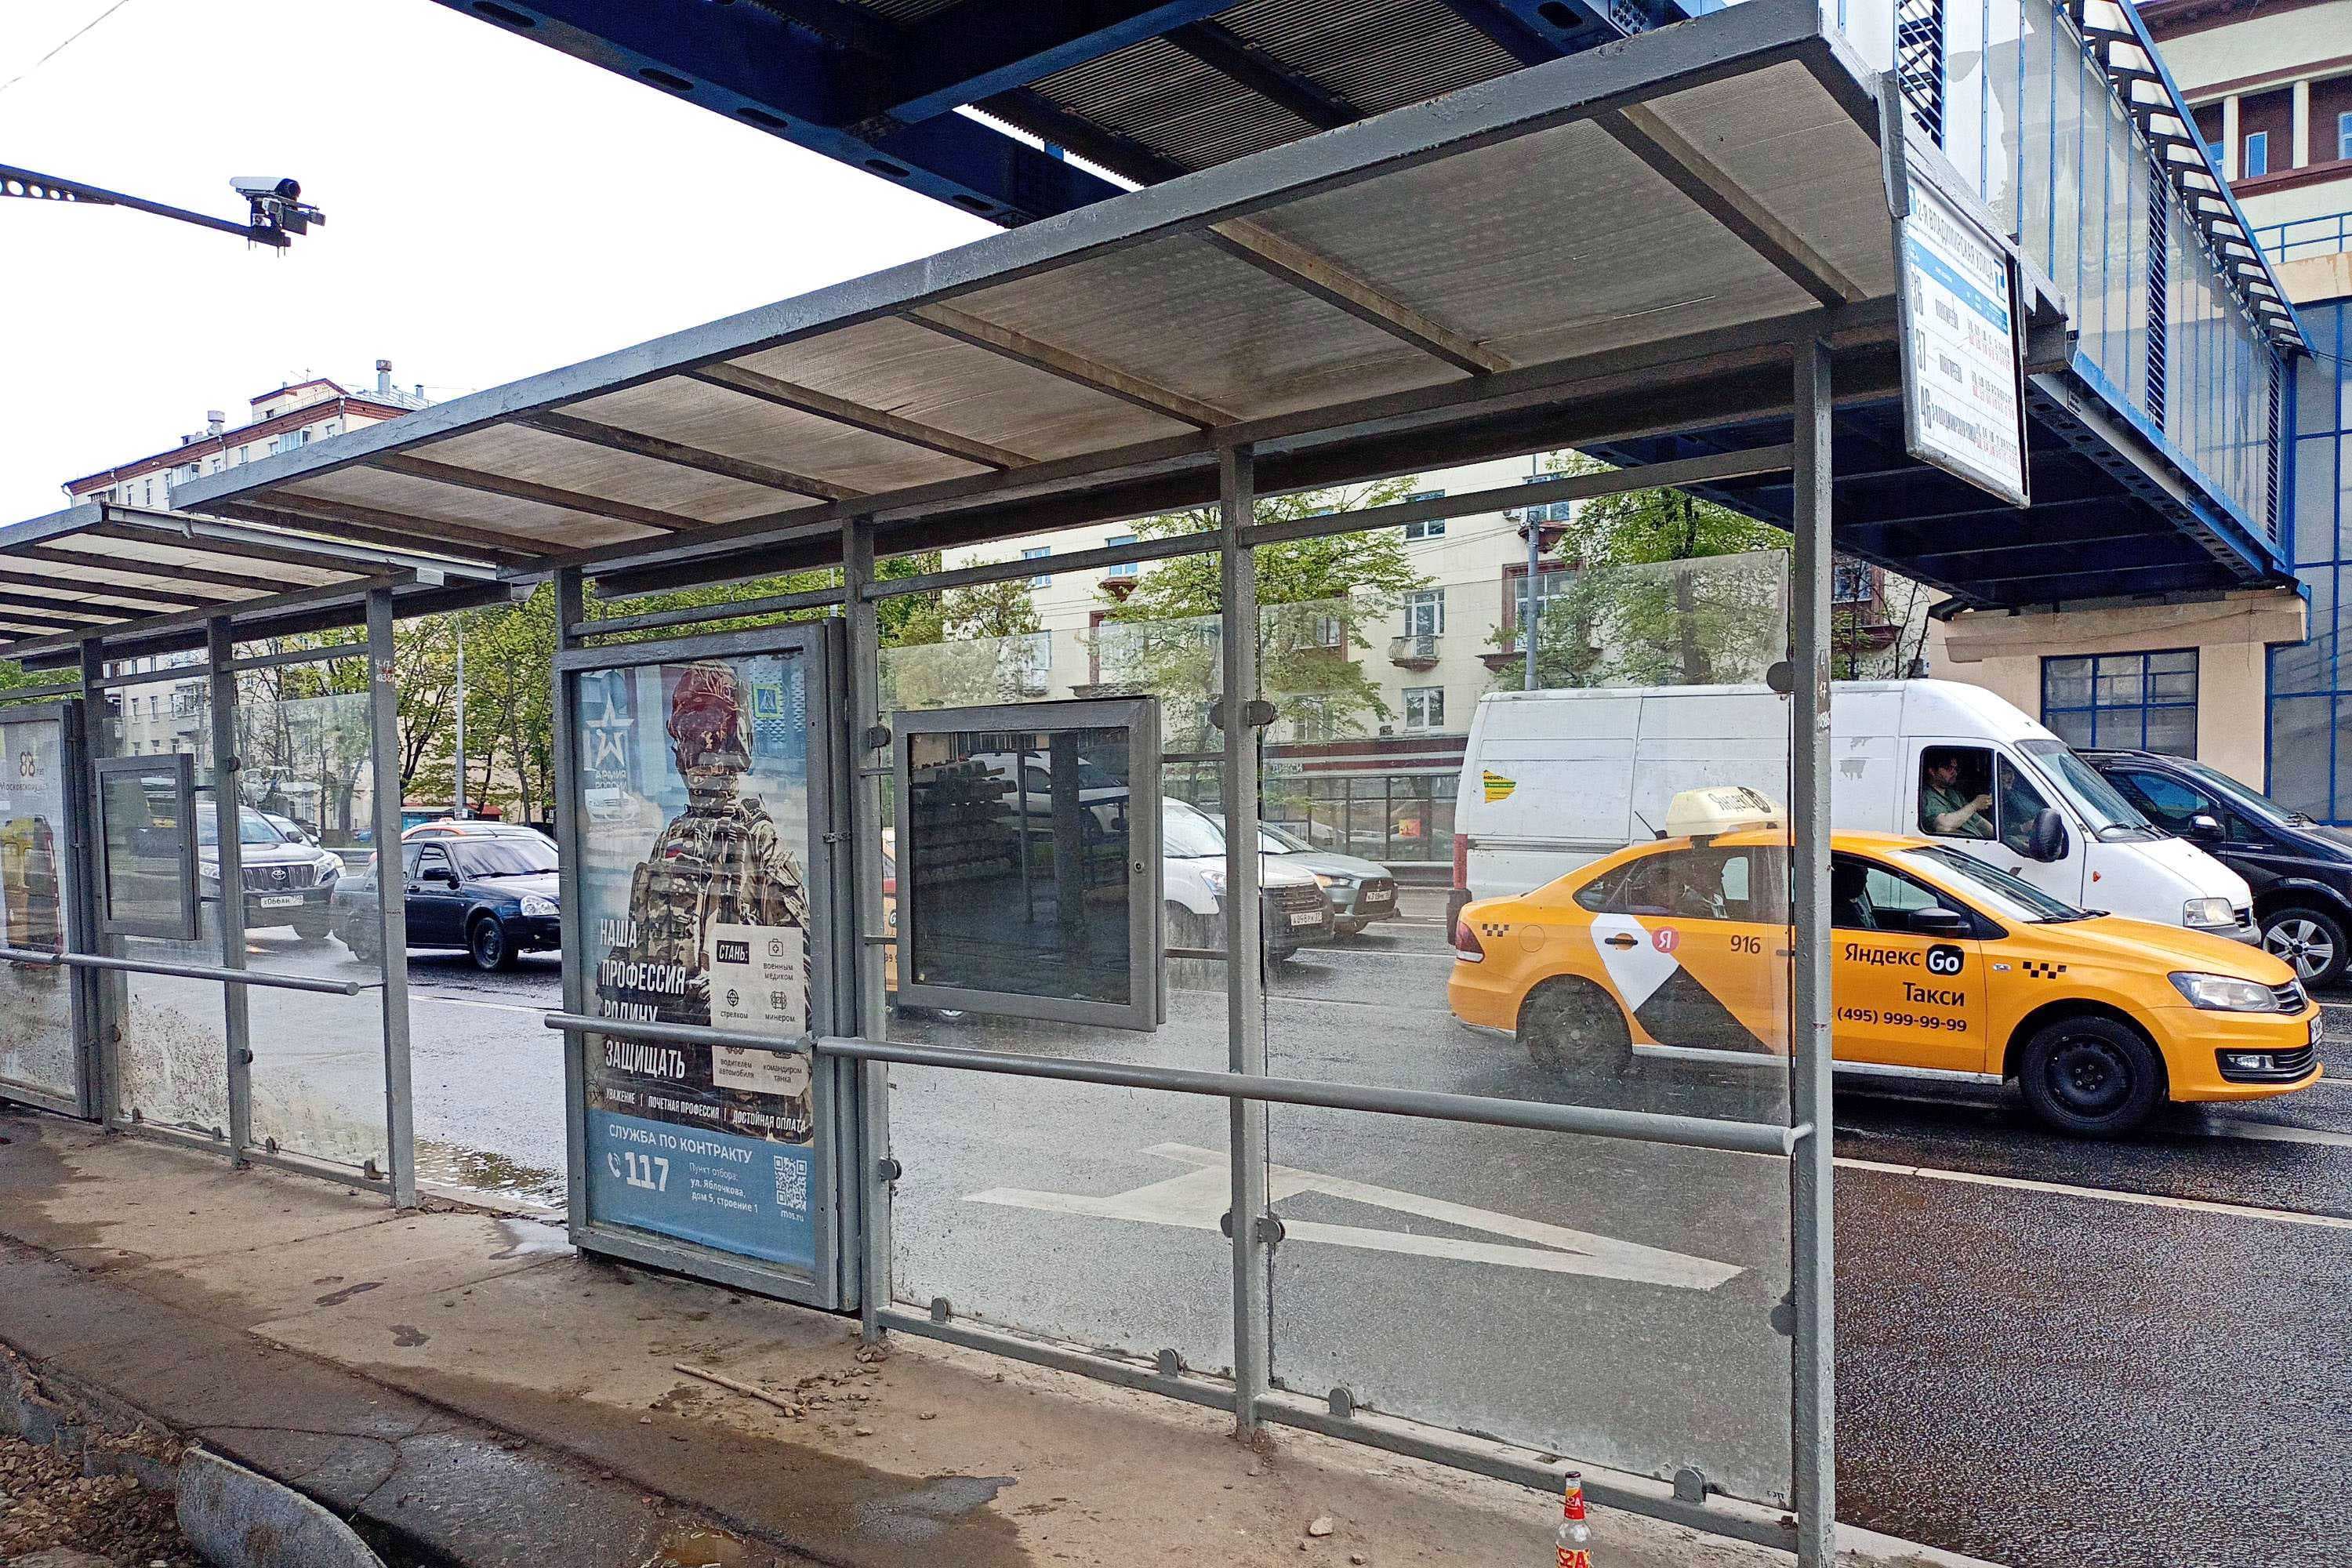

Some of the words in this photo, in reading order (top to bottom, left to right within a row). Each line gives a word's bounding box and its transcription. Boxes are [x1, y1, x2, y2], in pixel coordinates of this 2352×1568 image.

[1915, 328, 1926, 372] 37
[1920, 385, 1932, 430] 46
[20, 751, 35, 777] 88
[595, 770, 626, 779] АРМИЯ
[600, 918, 637, 949] НАША
[1657, 930, 1672, 949] Я
[719, 943, 749, 962] СТАНЬ:
[1730, 935, 1762, 956] 916
[763, 963, 794, 971] военным
[1844, 942, 1922, 967] Яндекс
[1928, 949, 1960, 973] Go
[601, 959, 687, 995] ПРОФЕССИЯ
[764, 972, 794, 982] медиком
[1902, 981, 1965, 1007] Такси
[720, 1010, 749, 1020] стрелком
[1837, 1007, 1878, 1025] (495)
[1882, 1011, 1968, 1033] 999-99-99
[605, 1040, 686, 1080] ЗАЩИЩАТЬ
[720, 1058, 753, 1069] водителем
[763, 1063, 803, 1075] командиром
[719, 1067, 754, 1080] автомобиля
[774, 1075, 792, 1083] танка
[606, 1087, 636, 1105] УВАЖЕНИЕ
[648, 1095, 680, 1113] ПОЧЕТНАЯ
[681, 1102, 720, 1120] ПРОФЕССИЯ
[732, 1109, 775, 1129] ДОСТОЙНАЯ
[775, 1117, 806, 1134] ОПЛАТА
[609, 1123, 657, 1145] СЛУЖБА
[659, 1133, 677, 1149] ПО
[680, 1137, 753, 1164] КОНТРАКТУ
[624, 1150, 670, 1192] 117
[689, 1162, 711, 1175] Пункт
[690, 1178, 702, 1189] ул.
[703, 1179, 746, 1199] Яблочкова,
[691, 1191, 707, 1202] дом
[717, 1196, 753, 1211] строение
[780, 1210, 804, 1222] mos.ru
